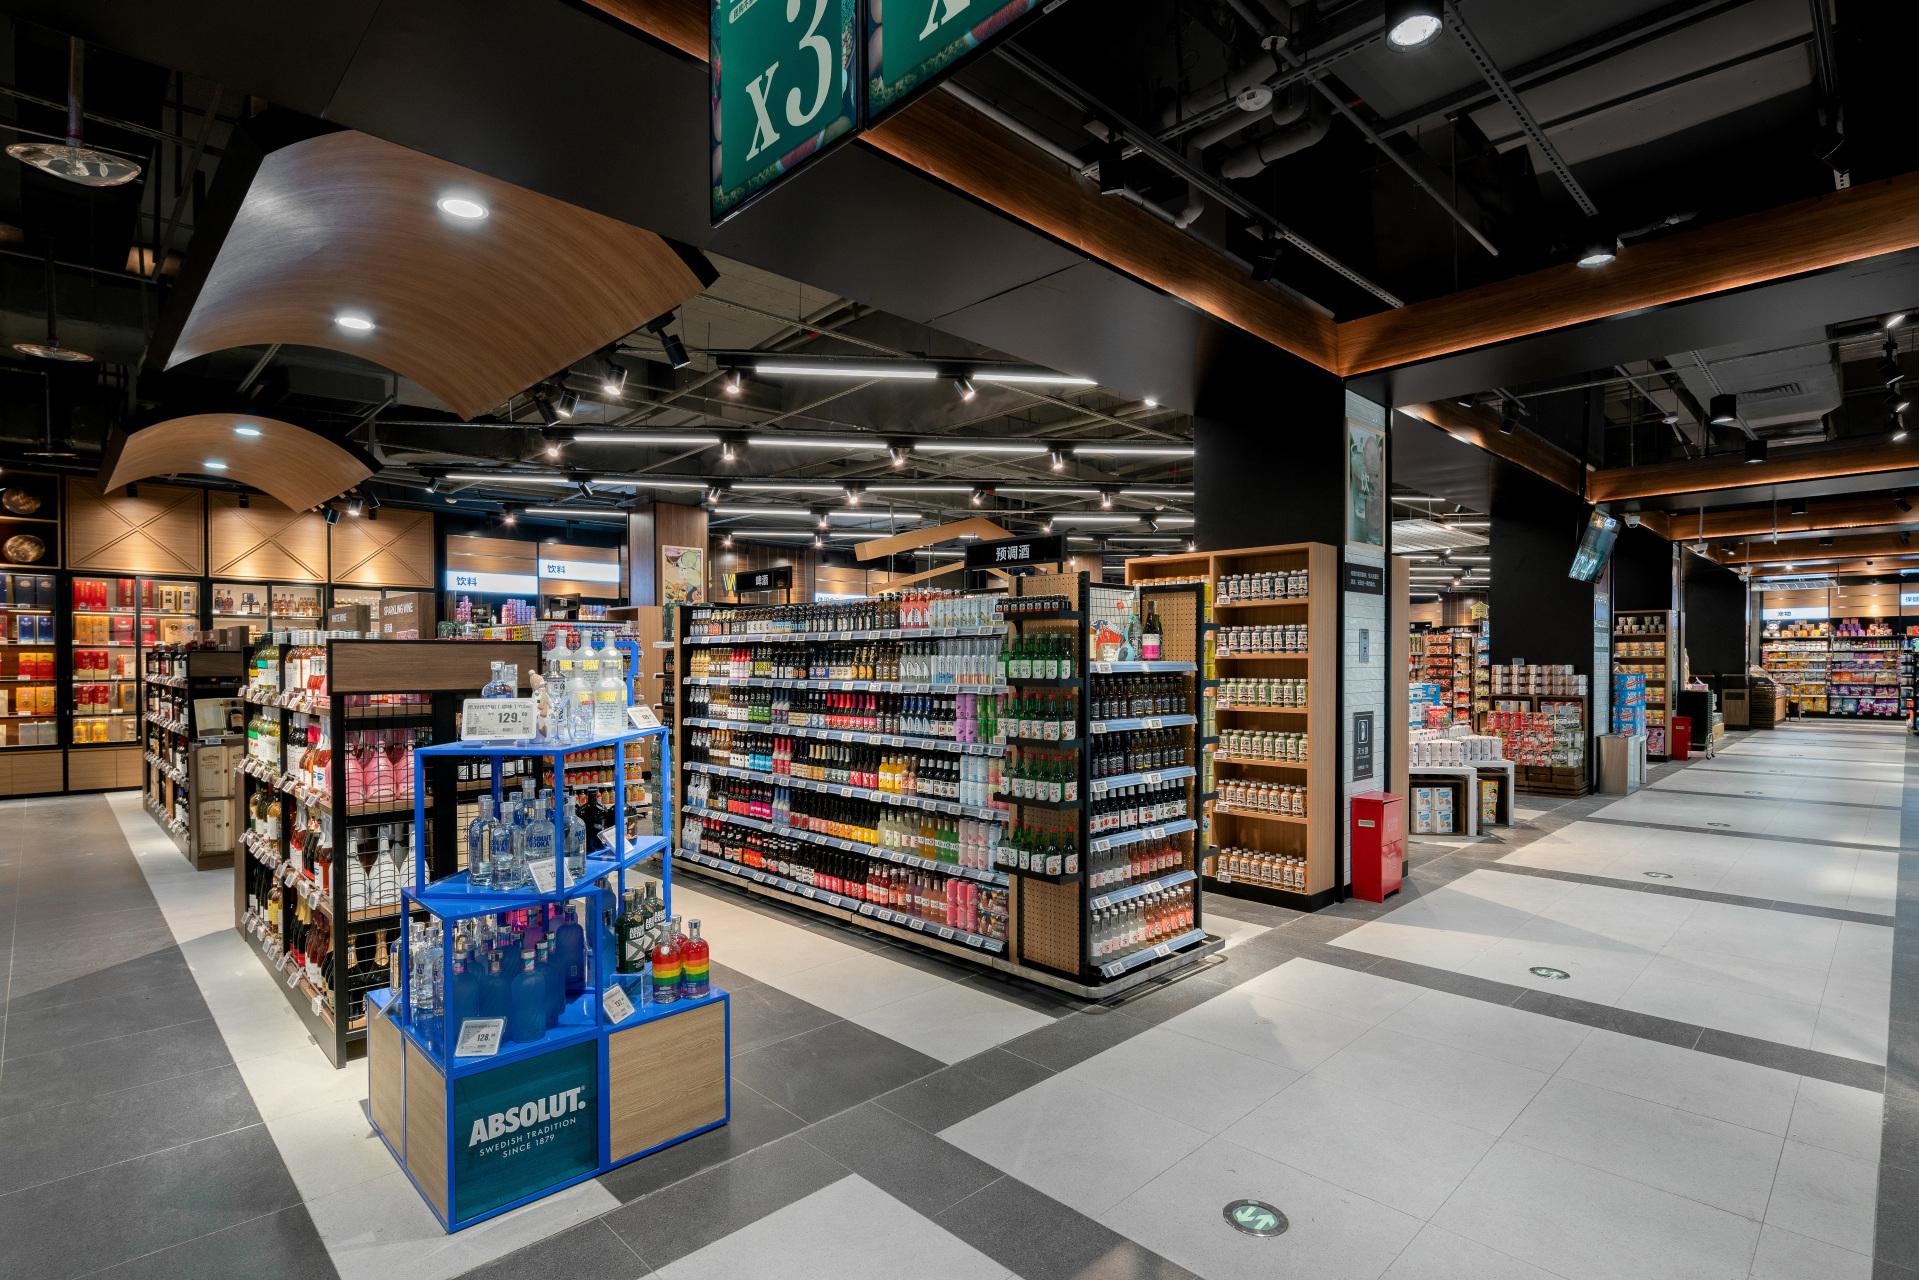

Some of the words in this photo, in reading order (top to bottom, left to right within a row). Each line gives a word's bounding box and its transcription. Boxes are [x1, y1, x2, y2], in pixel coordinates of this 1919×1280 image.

[995, 544, 1031, 562] 预调酒
[547, 564, 566, 574] 饮料
[456, 576, 478, 587] 饮料
[479, 1135, 523, 1157] SWEDISH
[526, 1116, 576, 1140] TRADITION
[502, 1142, 531, 1158] SINCE
[535, 1133, 555, 1147] 1879
